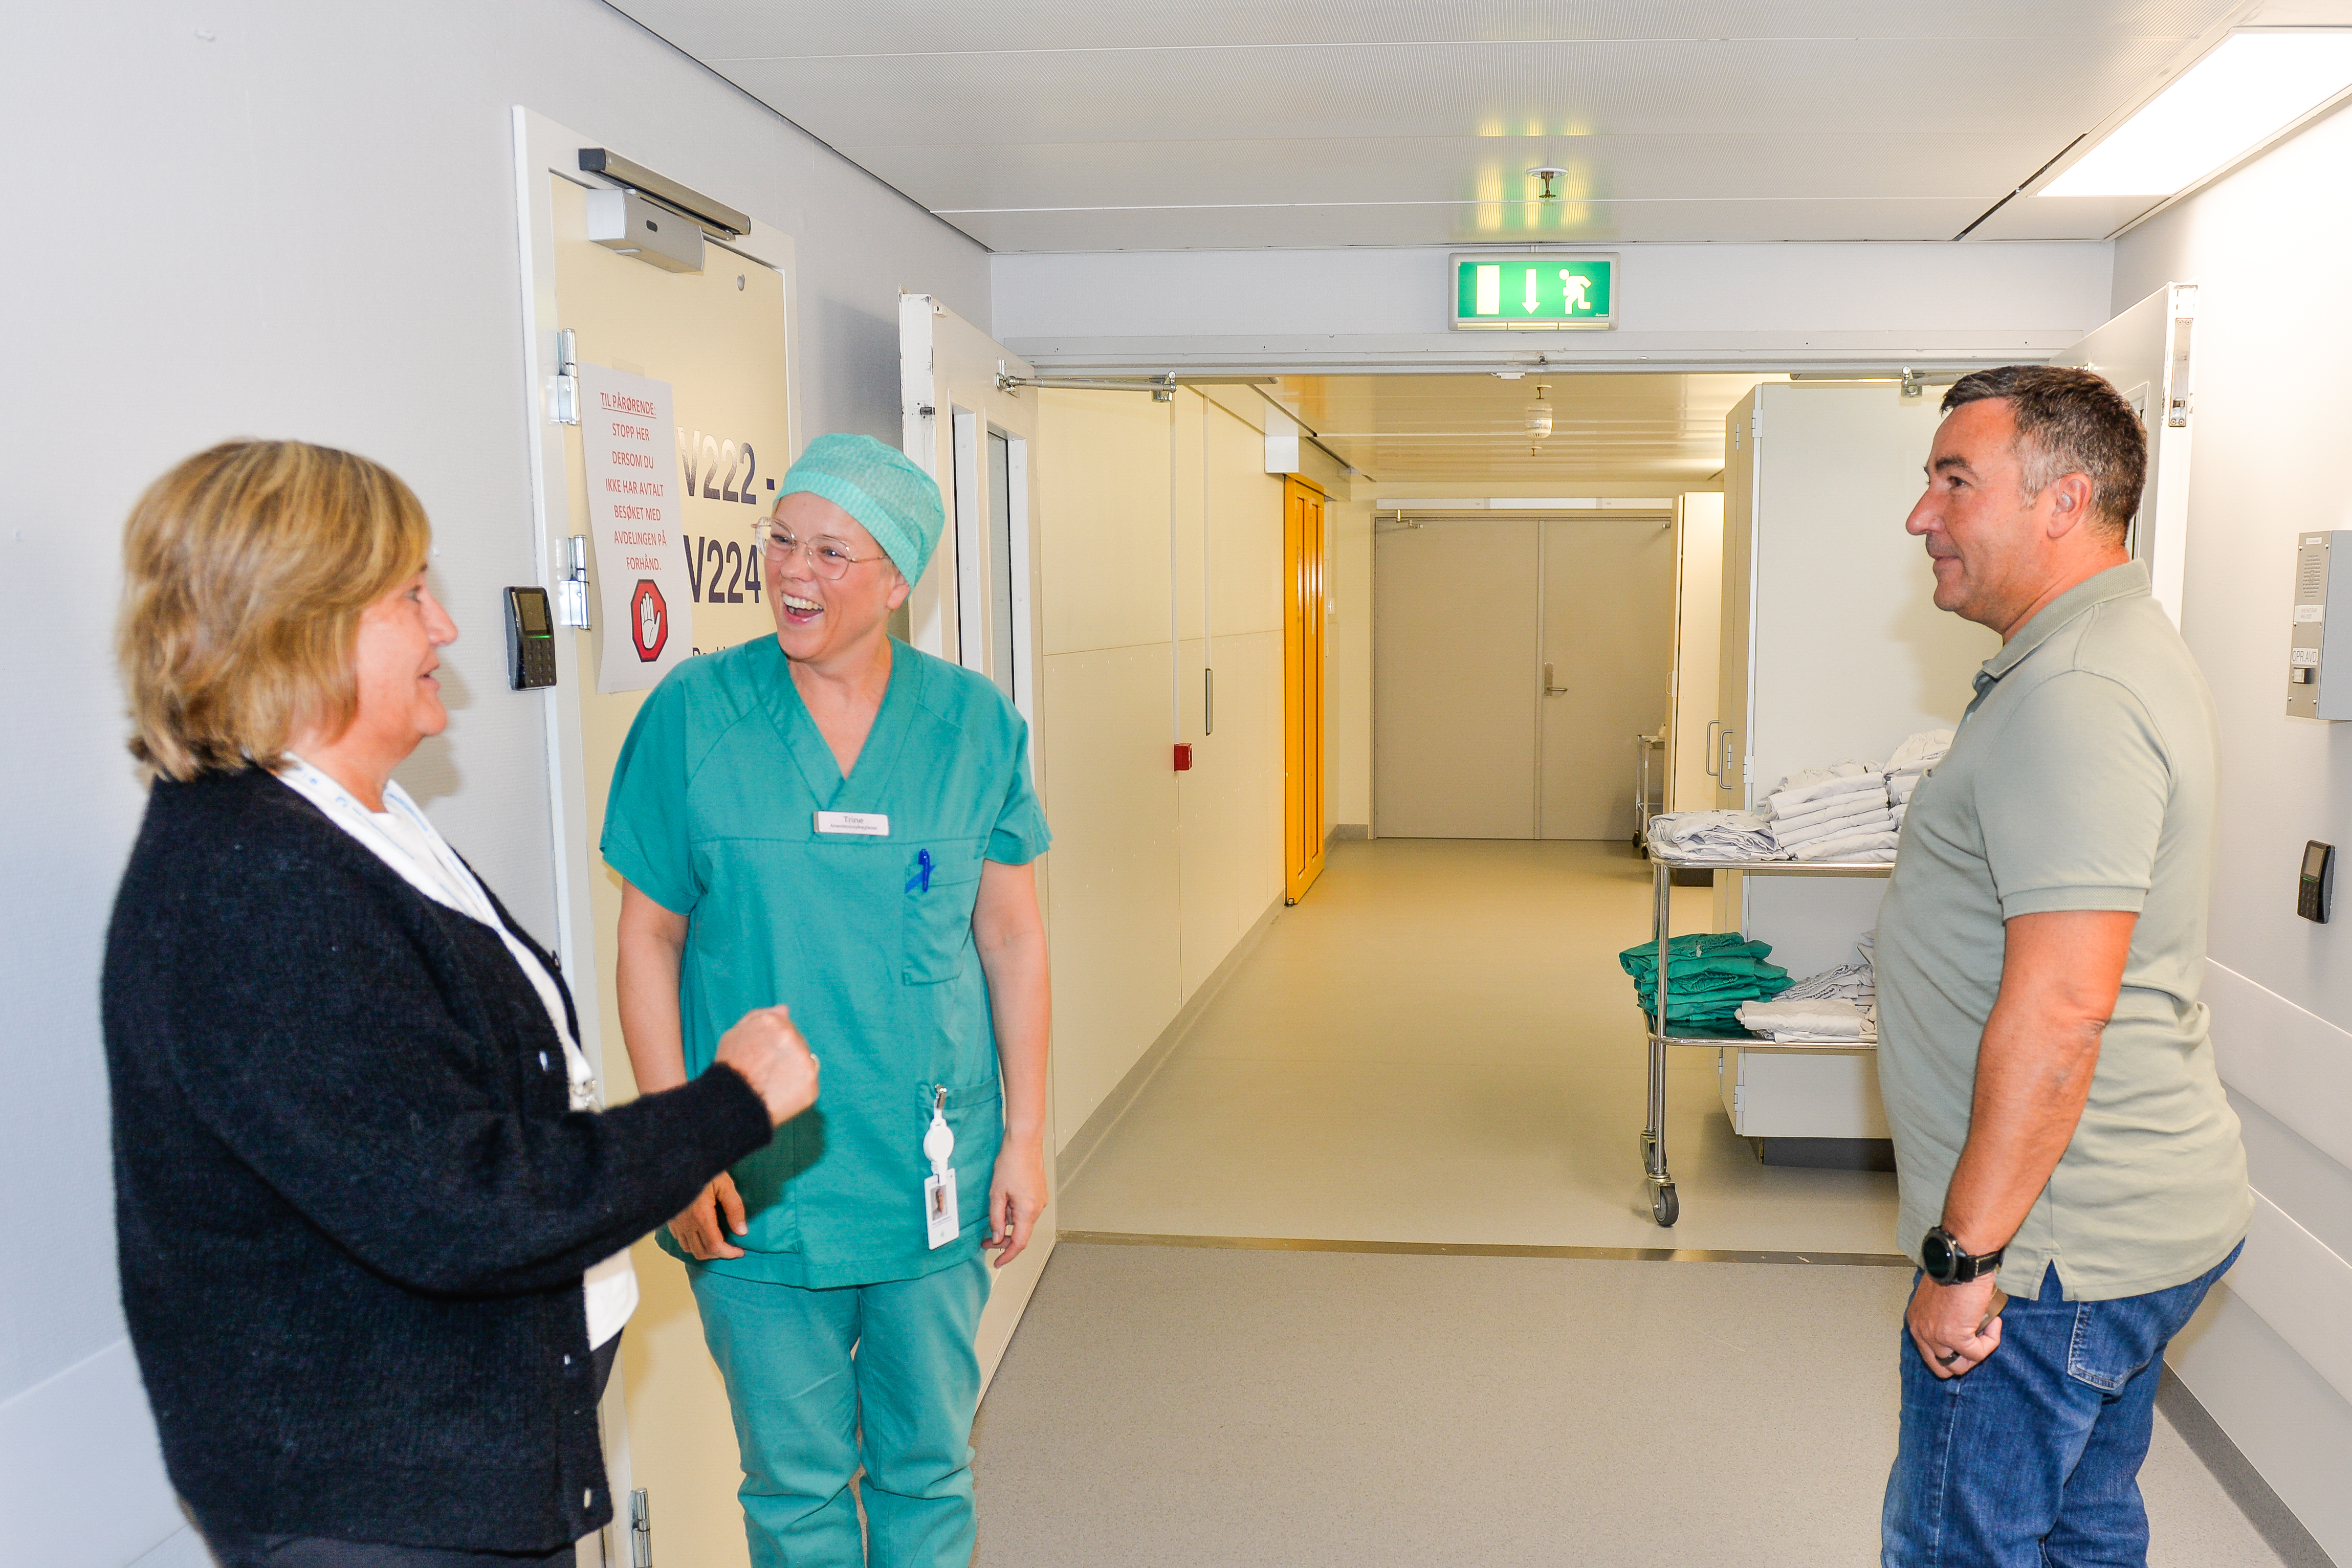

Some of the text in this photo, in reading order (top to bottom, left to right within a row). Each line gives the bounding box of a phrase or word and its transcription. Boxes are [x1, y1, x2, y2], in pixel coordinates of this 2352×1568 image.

[600, 391, 656, 415] TIL PÅRØRENDE:
[612, 423, 650, 441] STOPP HER
[612, 451, 654, 469] DERSOM DU
[676, 426, 757, 505] V222
[605, 478, 664, 497] IKKE HAR AVTALT
[614, 504, 661, 521] BESØKET MED
[614, 529, 667, 546] AVDELINGEN PÅ
[626, 554, 662, 571] FORHÅND.
[683, 534, 761, 604] V224
